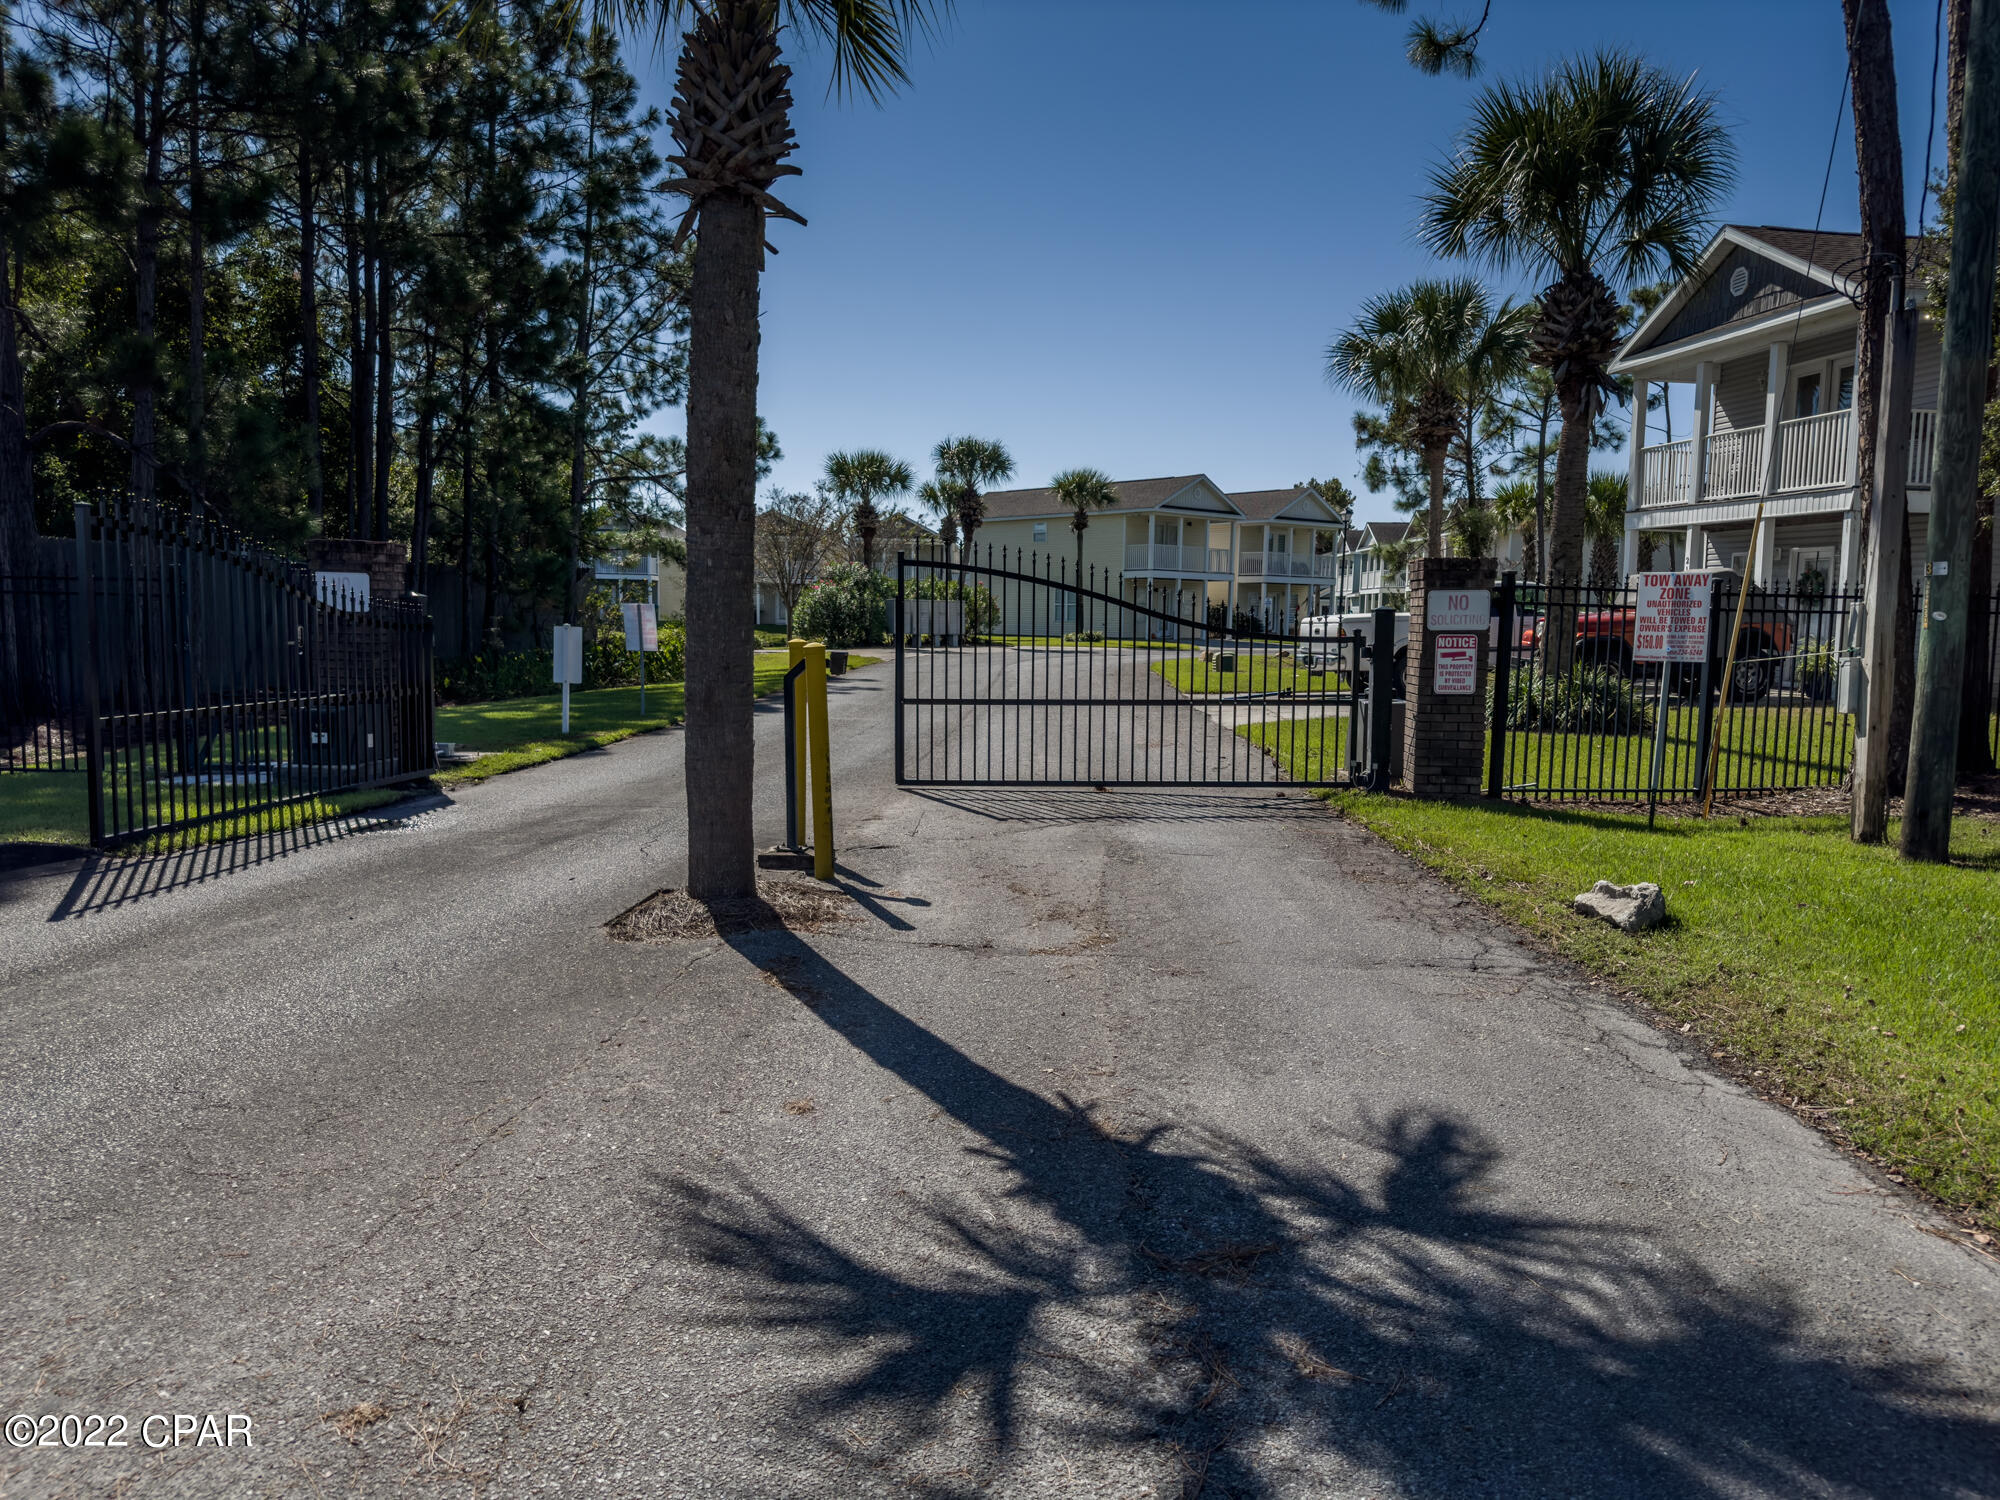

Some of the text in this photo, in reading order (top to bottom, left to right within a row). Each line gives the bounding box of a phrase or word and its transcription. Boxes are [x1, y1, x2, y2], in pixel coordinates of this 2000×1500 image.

[1643, 574, 1710, 587] TOW AWAY
[1659, 587, 1691, 600] ZONE
[1448, 594, 1469, 611] NO
[1646, 600, 1703, 608] UNAUTHORIZED
[1657, 608, 1691, 616] VEHICLES
[1430, 614, 1486, 626] SOLICITING
[1639, 616, 1707, 624] WILL BE TOWED AT
[1639, 625, 1706, 633] OWNER'S EXPENSE
[1438, 637, 1476, 648] NOTICE
[1637, 633, 1664, 651] $150.00
